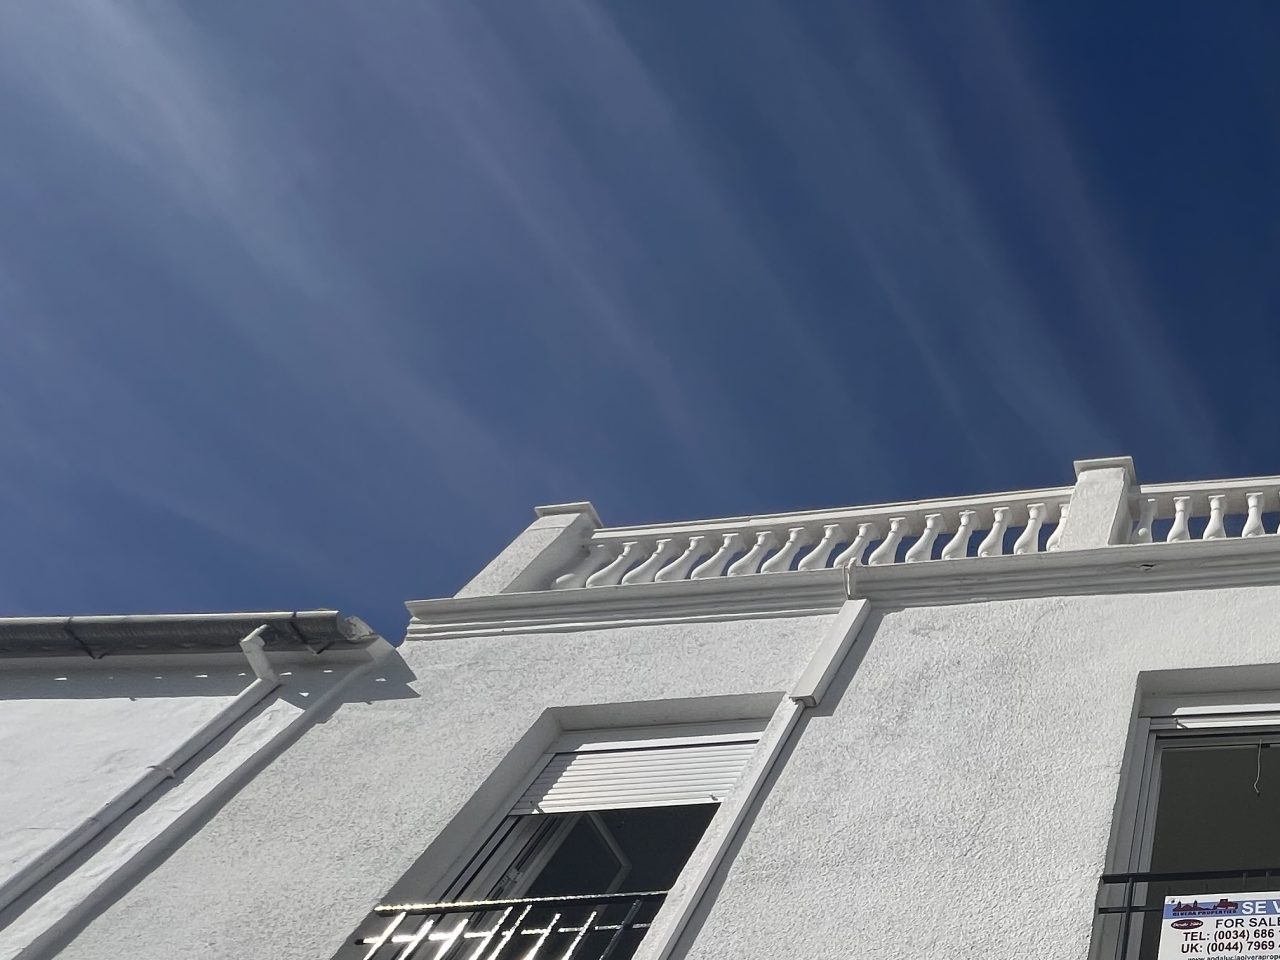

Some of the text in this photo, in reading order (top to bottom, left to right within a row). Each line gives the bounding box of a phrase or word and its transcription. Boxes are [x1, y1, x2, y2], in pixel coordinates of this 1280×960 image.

[1241, 900, 1267, 915] SE
[1215, 918, 1244, 929] FOR
[1183, 931, 1210, 942] TEL:
[1213, 929, 1250, 942] (0034)
[1253, 928, 1275, 939] 686
[1181, 943, 1203, 954] UK:
[1206, 941, 1243, 954] (0044)
[1246, 940, 1275, 951] 7969
